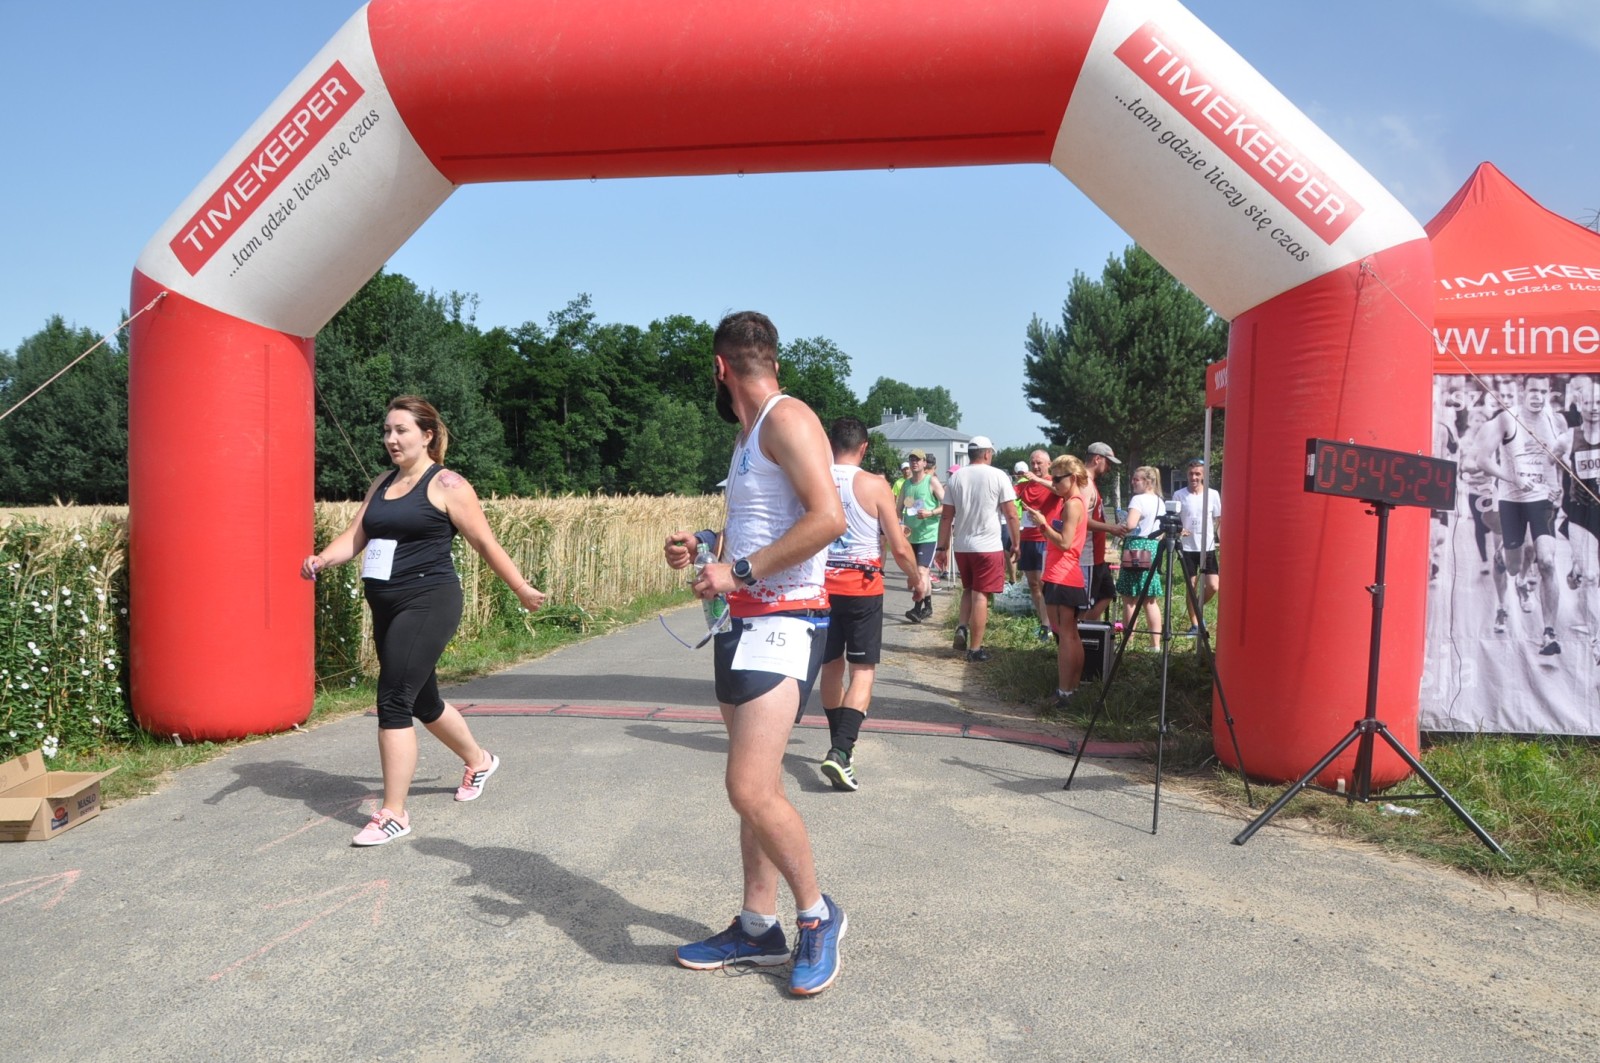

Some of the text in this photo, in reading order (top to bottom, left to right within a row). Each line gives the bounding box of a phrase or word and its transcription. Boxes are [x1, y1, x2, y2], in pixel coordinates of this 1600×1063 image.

[182, 76, 348, 252] TIMEKEEPER
[1114, 94, 1310, 262] ...tam gdzie liczy się czas
[1142, 36, 1345, 226] TIMEKEEPER
[229, 108, 380, 277] ...tam gdzie liczy się czas
[1433, 264, 1600, 289] IMEKEE
[1504, 282, 1563, 296] gdzie
[1317, 445, 1452, 502] 09:45:24
[765, 631, 787, 647] 45
